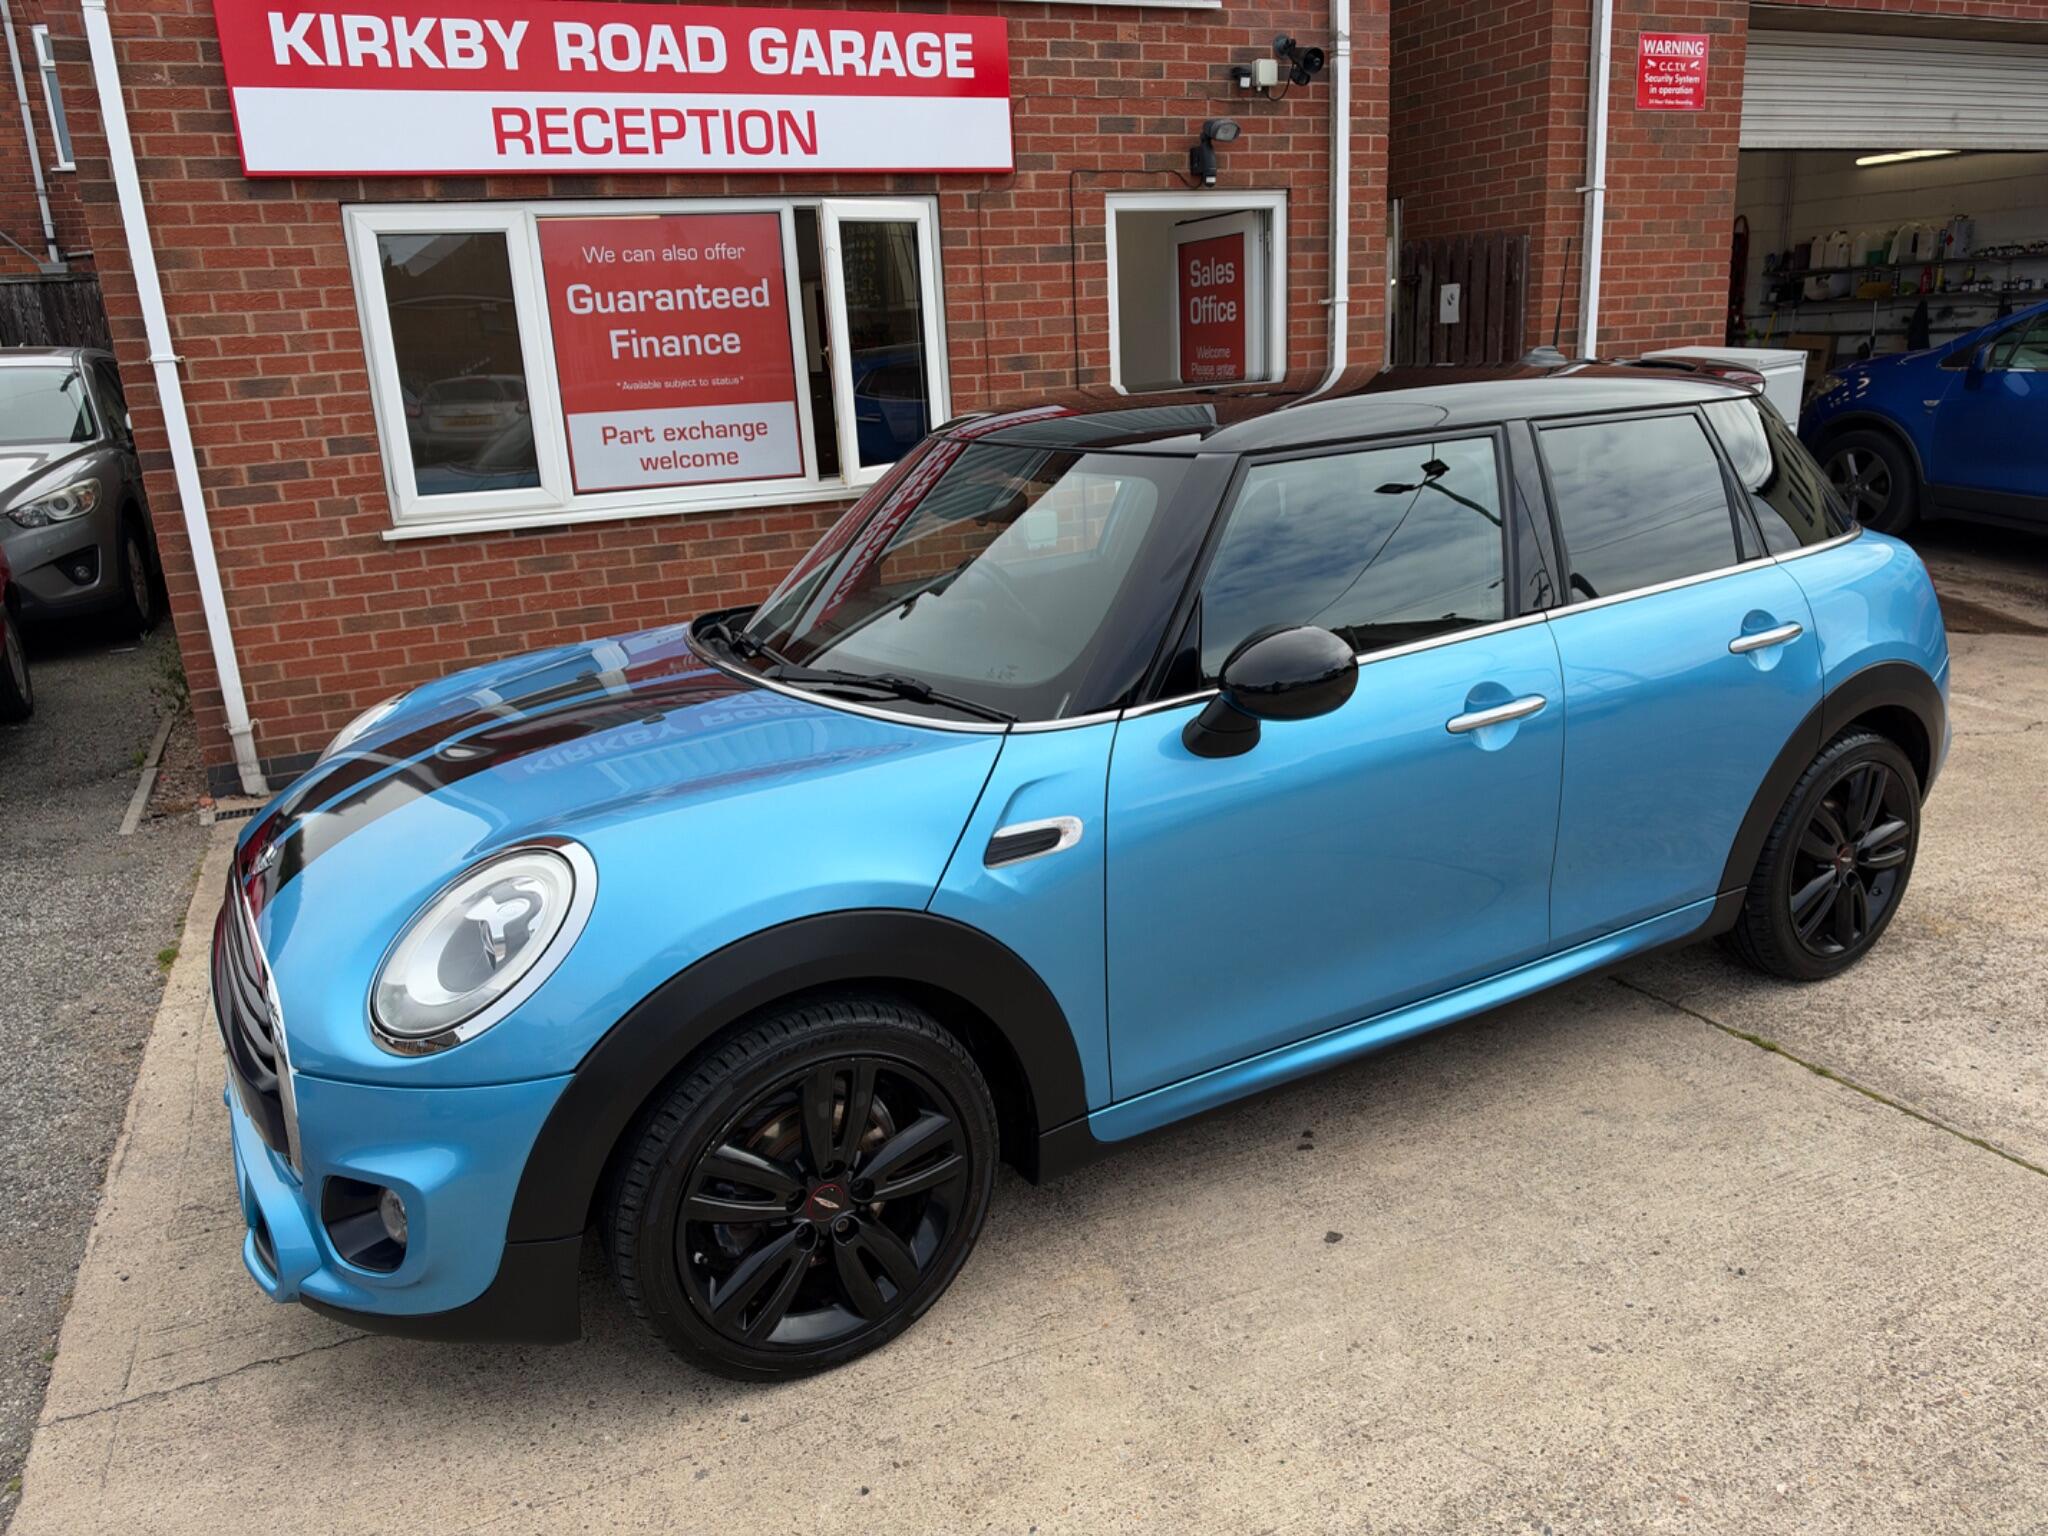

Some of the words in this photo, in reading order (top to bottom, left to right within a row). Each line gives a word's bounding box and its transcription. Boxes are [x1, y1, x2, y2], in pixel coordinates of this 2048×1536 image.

[268, 11, 529, 70] KIRKBY
[553, 21, 728, 74] ROAD
[748, 27, 975, 78] GARAGE
[1643, 40, 1704, 56] WARNING
[1644, 72, 1673, 84] Security
[1675, 73, 1700, 84] System
[1649, 84, 1657, 94] in
[1658, 86, 1693, 96] operation
[491, 107, 818, 155] RECEPTION
[582, 246, 615, 263] We
[622, 247, 655, 263] can
[662, 244, 697, 262] also
[704, 243, 745, 259] offer
[1190, 257, 1235, 287] Sales
[566, 278, 770, 314] Guaranteed
[1190, 295, 1237, 325] Office
[609, 329, 741, 360] Finance
[1196, 345, 1231, 359] Welcome
[664, 379, 697, 390] subject
[700, 378, 709, 387] to
[601, 425, 655, 446] Part
[663, 420, 768, 443] exchange
[640, 450, 739, 472] welcome
